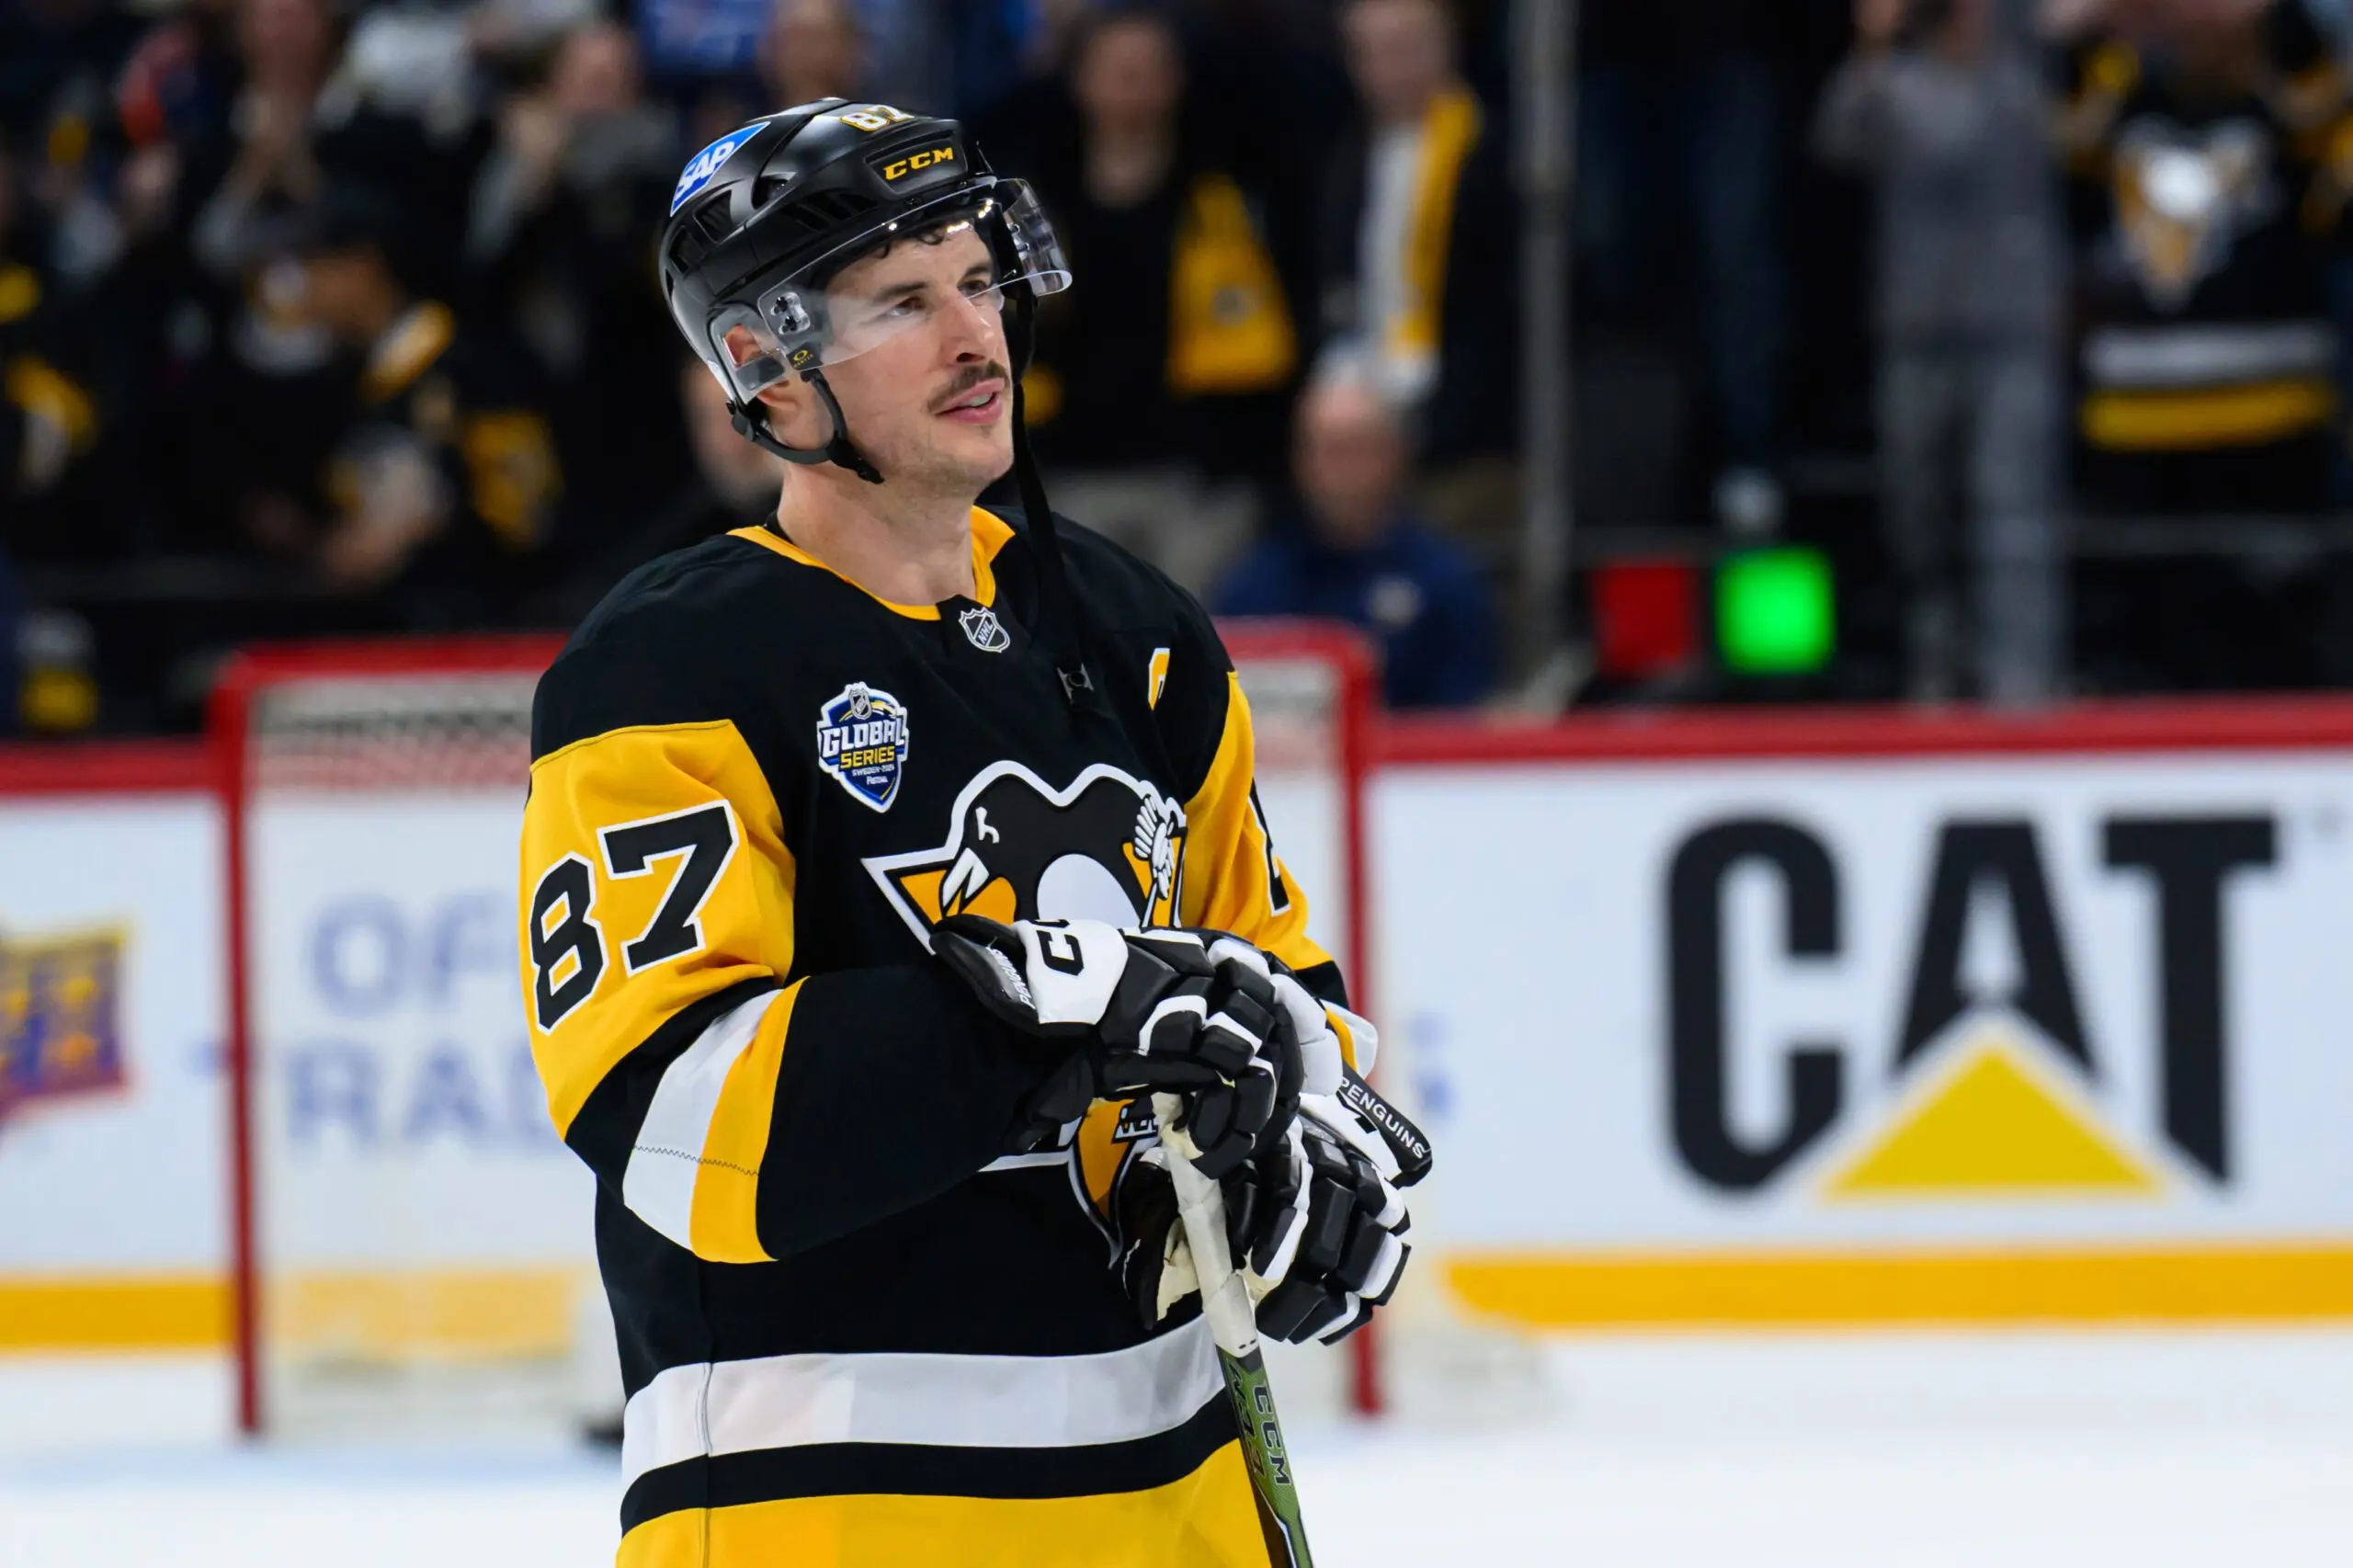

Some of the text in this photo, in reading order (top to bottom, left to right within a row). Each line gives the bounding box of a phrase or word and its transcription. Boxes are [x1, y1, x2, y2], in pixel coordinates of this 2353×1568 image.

[838, 104, 915, 131] 87
[675, 142, 735, 202] SAP
[883, 146, 954, 180] CCM
[821, 717, 905, 758] GLOBAL
[840, 745, 895, 769] SERIES
[530, 800, 739, 1037] 87
[1660, 811, 2280, 1197] CAT
[1340, 1075, 1425, 1160] PENGUINS
[1253, 1383, 1291, 1486] CCM
